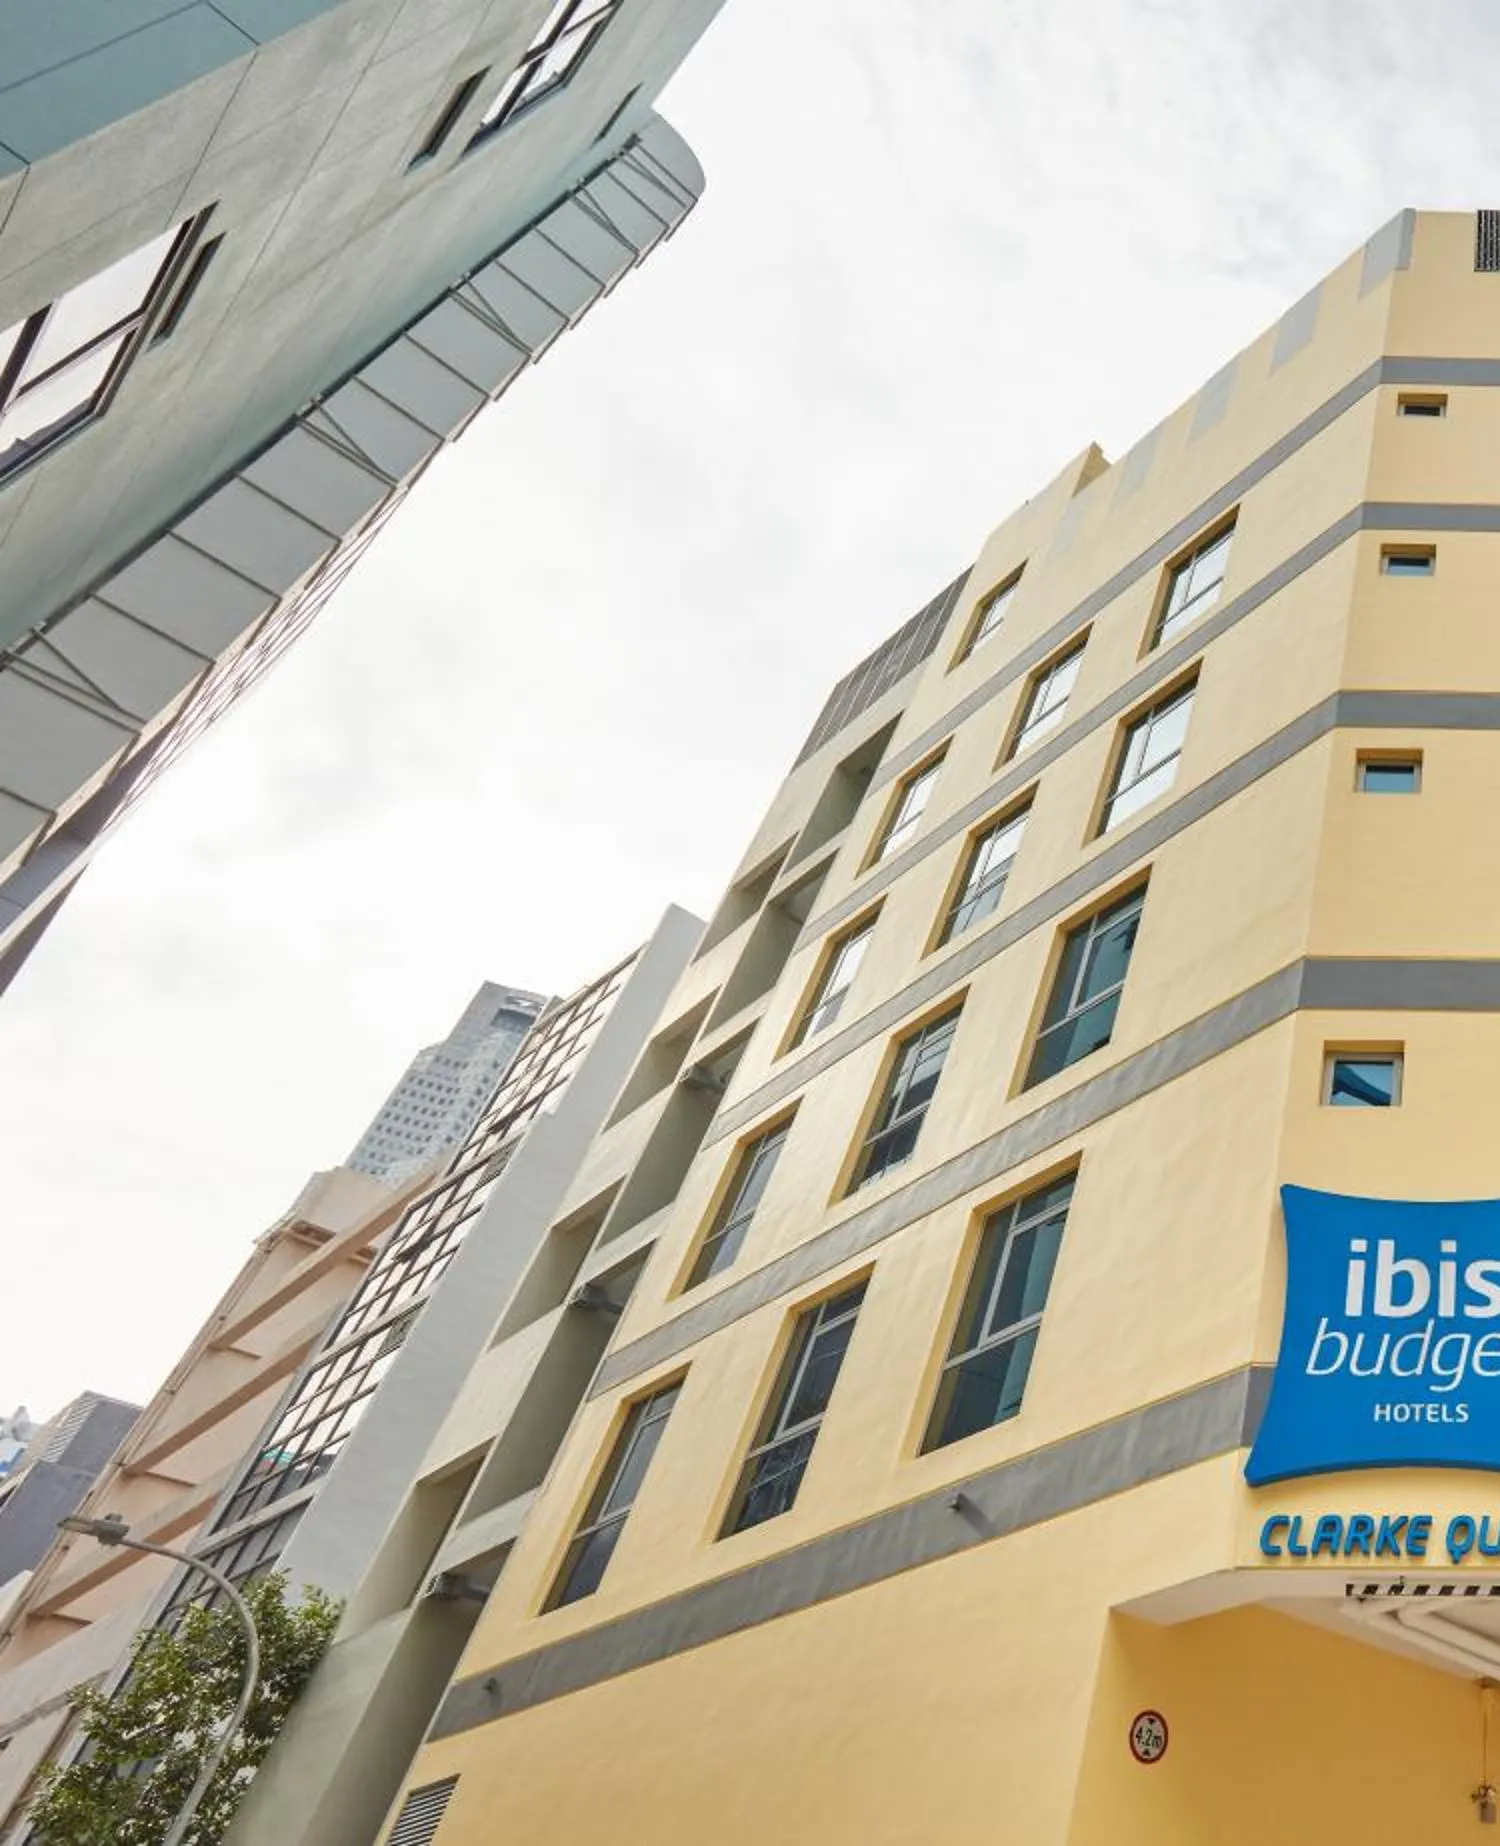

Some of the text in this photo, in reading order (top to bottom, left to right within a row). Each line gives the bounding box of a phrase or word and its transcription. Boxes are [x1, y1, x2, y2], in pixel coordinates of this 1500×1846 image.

[1373, 1403, 1470, 1424] HOTELS
[1260, 1513, 1433, 1558] CLARKE
[1135, 1726, 1163, 1749] 4.2m
